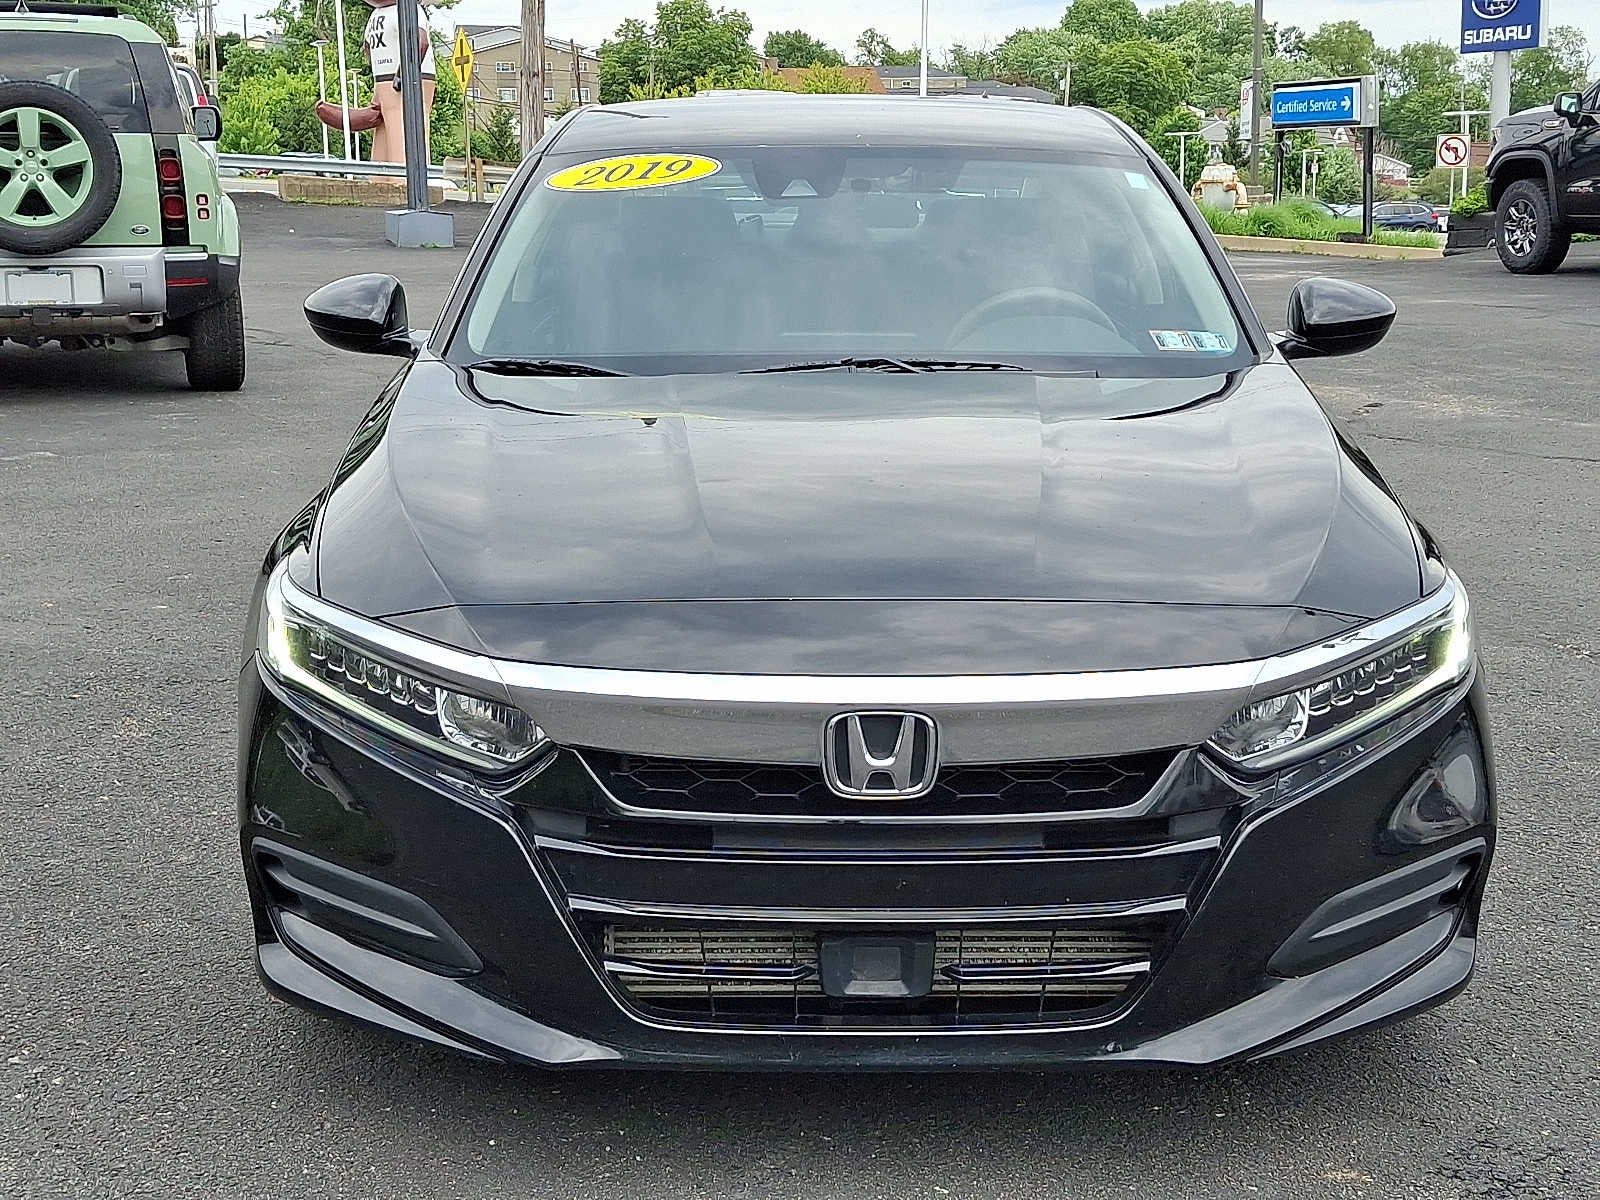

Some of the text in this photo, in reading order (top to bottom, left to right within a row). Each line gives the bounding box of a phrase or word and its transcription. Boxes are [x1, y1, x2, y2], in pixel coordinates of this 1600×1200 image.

[1463, 24, 1532, 45] SUBARU
[1276, 97, 1338, 114] Certified Service
[574, 159, 694, 187] 2019
